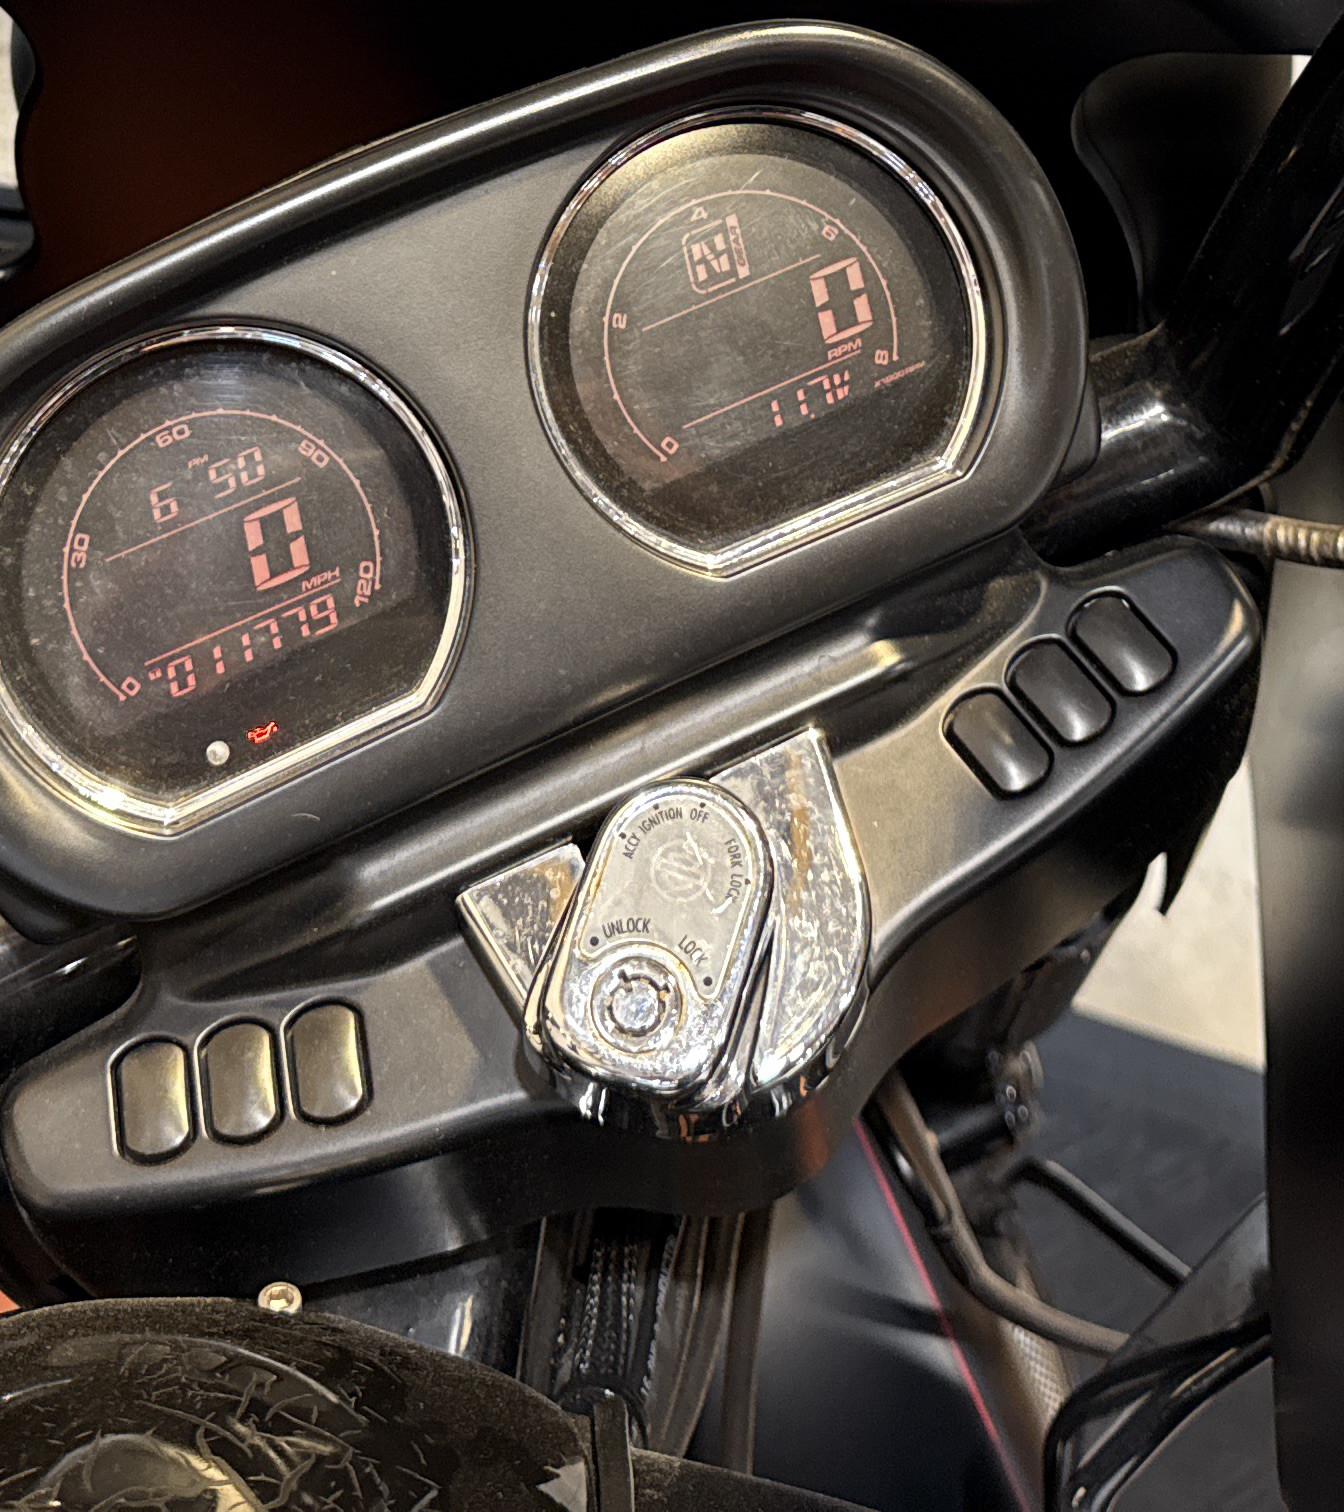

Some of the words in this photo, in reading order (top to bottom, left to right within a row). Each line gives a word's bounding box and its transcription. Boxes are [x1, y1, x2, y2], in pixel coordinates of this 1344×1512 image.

[689, 206, 709, 223] 4
[820, 224, 840, 241] 6
[810, 256, 874, 345] 0
[611, 311, 628, 329] 2
[827, 337, 863, 362] RPM
[874, 348, 890, 366] 8
[155, 423, 192, 448] 60
[660, 435, 680, 455] 0
[297, 438, 331, 469] 90
[69, 532, 91, 569] 30
[243, 496, 311, 592] 0
[300, 566, 341, 592] MPH
[353, 559, 375, 608] 120
[121, 675, 142, 698] 0
[622, 832, 641, 860] ACCY
[637, 806, 683, 835] IGNITION
[689, 807, 711, 824] OFF
[723, 837, 744, 869] FORK
[725, 872, 744, 904] LOCK
[602, 917, 652, 939] UNLOCK
[677, 933, 709, 966] LOCK
